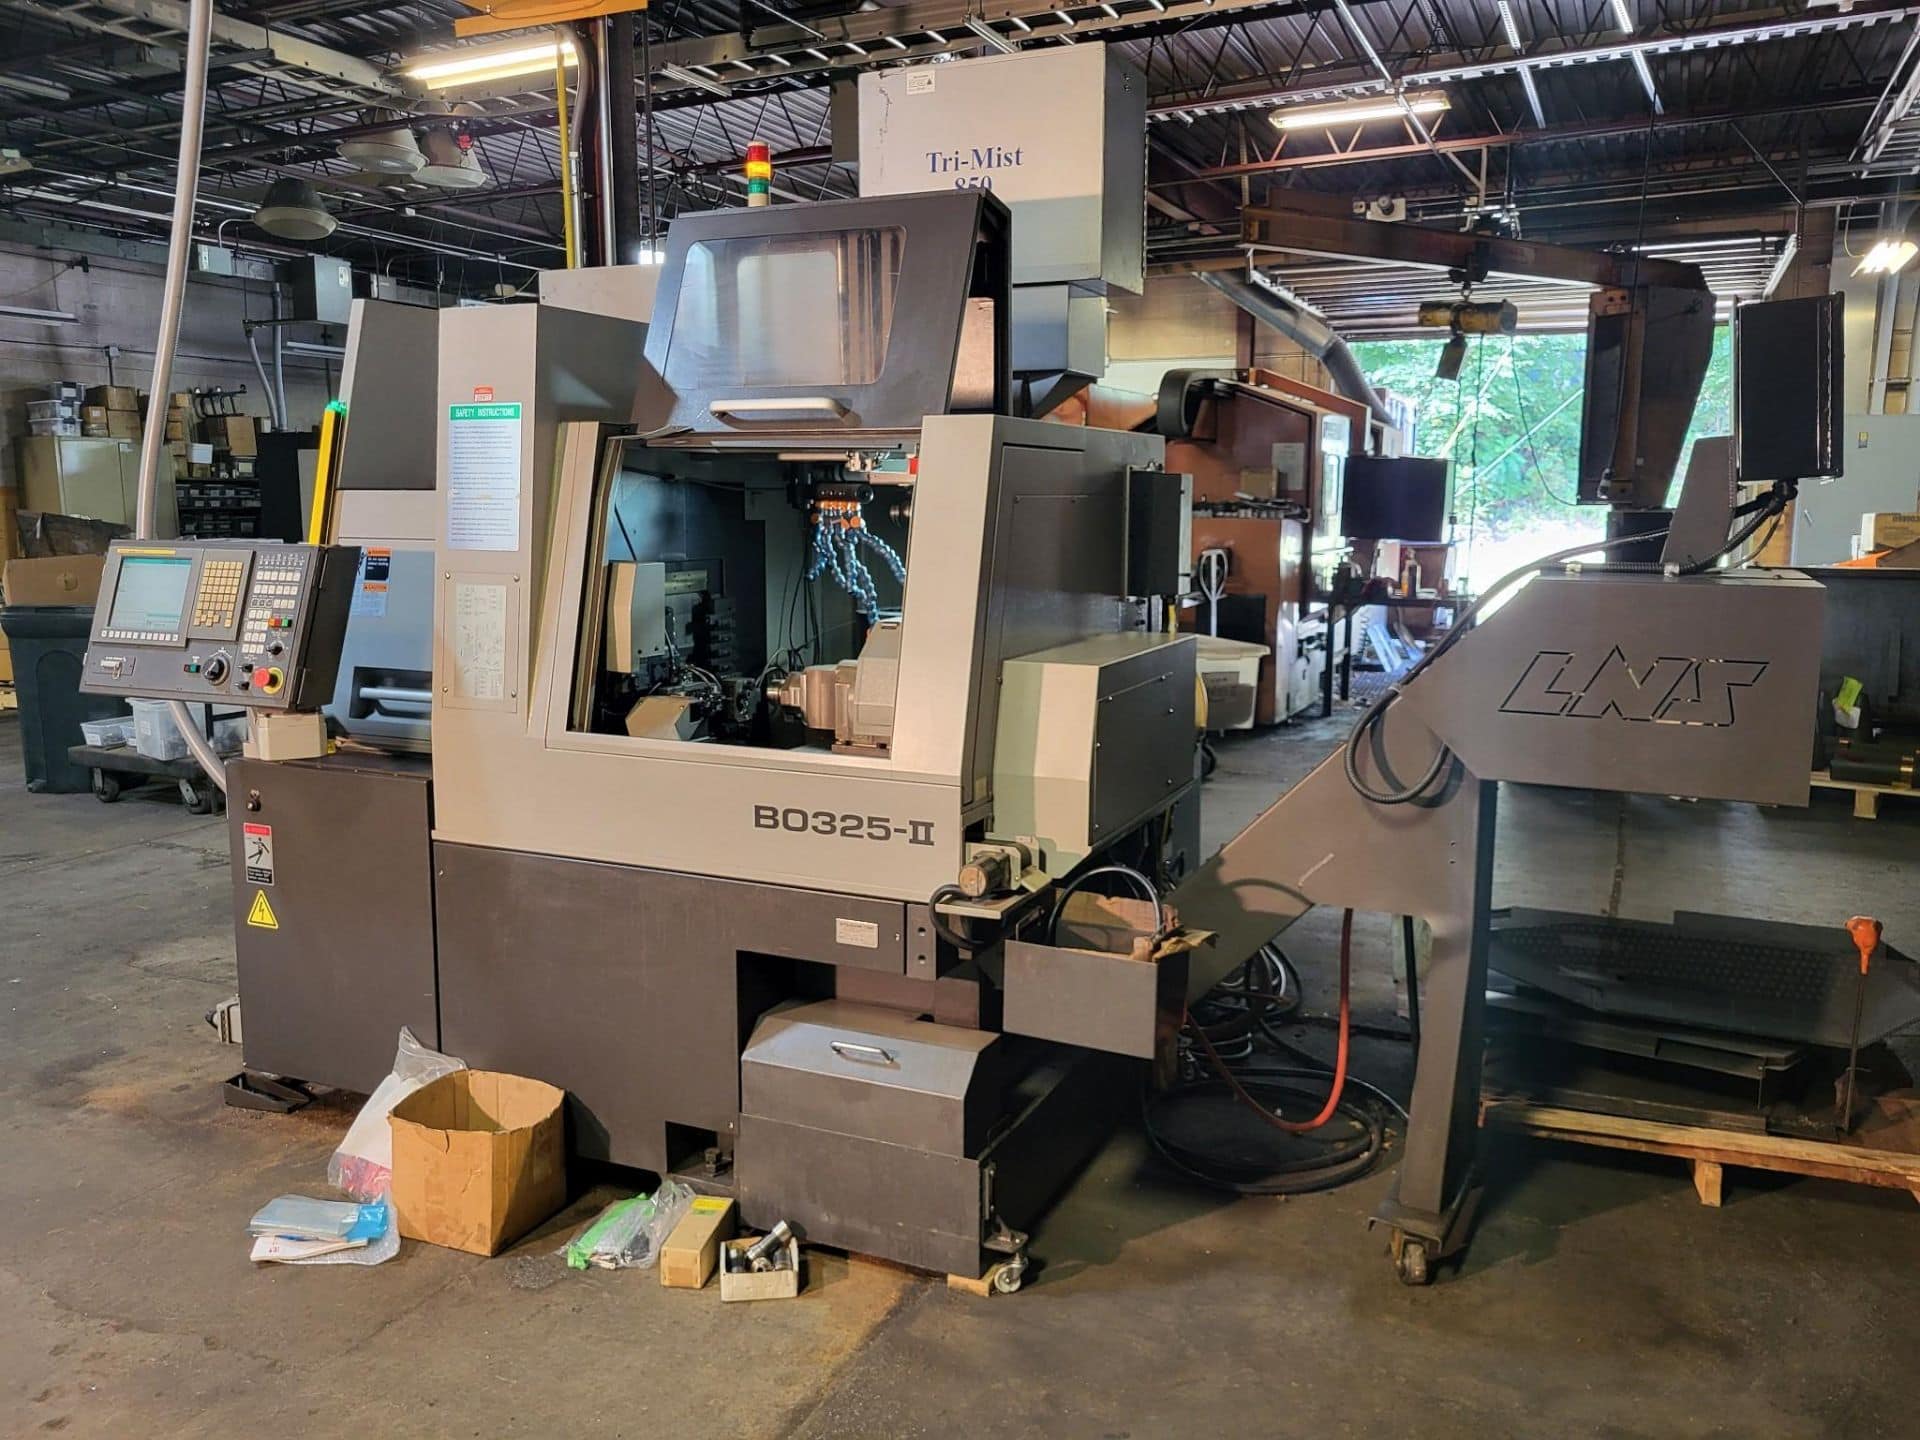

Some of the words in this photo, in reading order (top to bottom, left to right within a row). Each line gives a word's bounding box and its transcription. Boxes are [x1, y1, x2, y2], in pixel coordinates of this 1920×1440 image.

[926, 147, 1024, 173] Tri-Mist
[455, 407, 475, 418] SAFETY
[477, 407, 515, 417] INSTRUCTIONS
[1498, 644, 1770, 727] LNS
